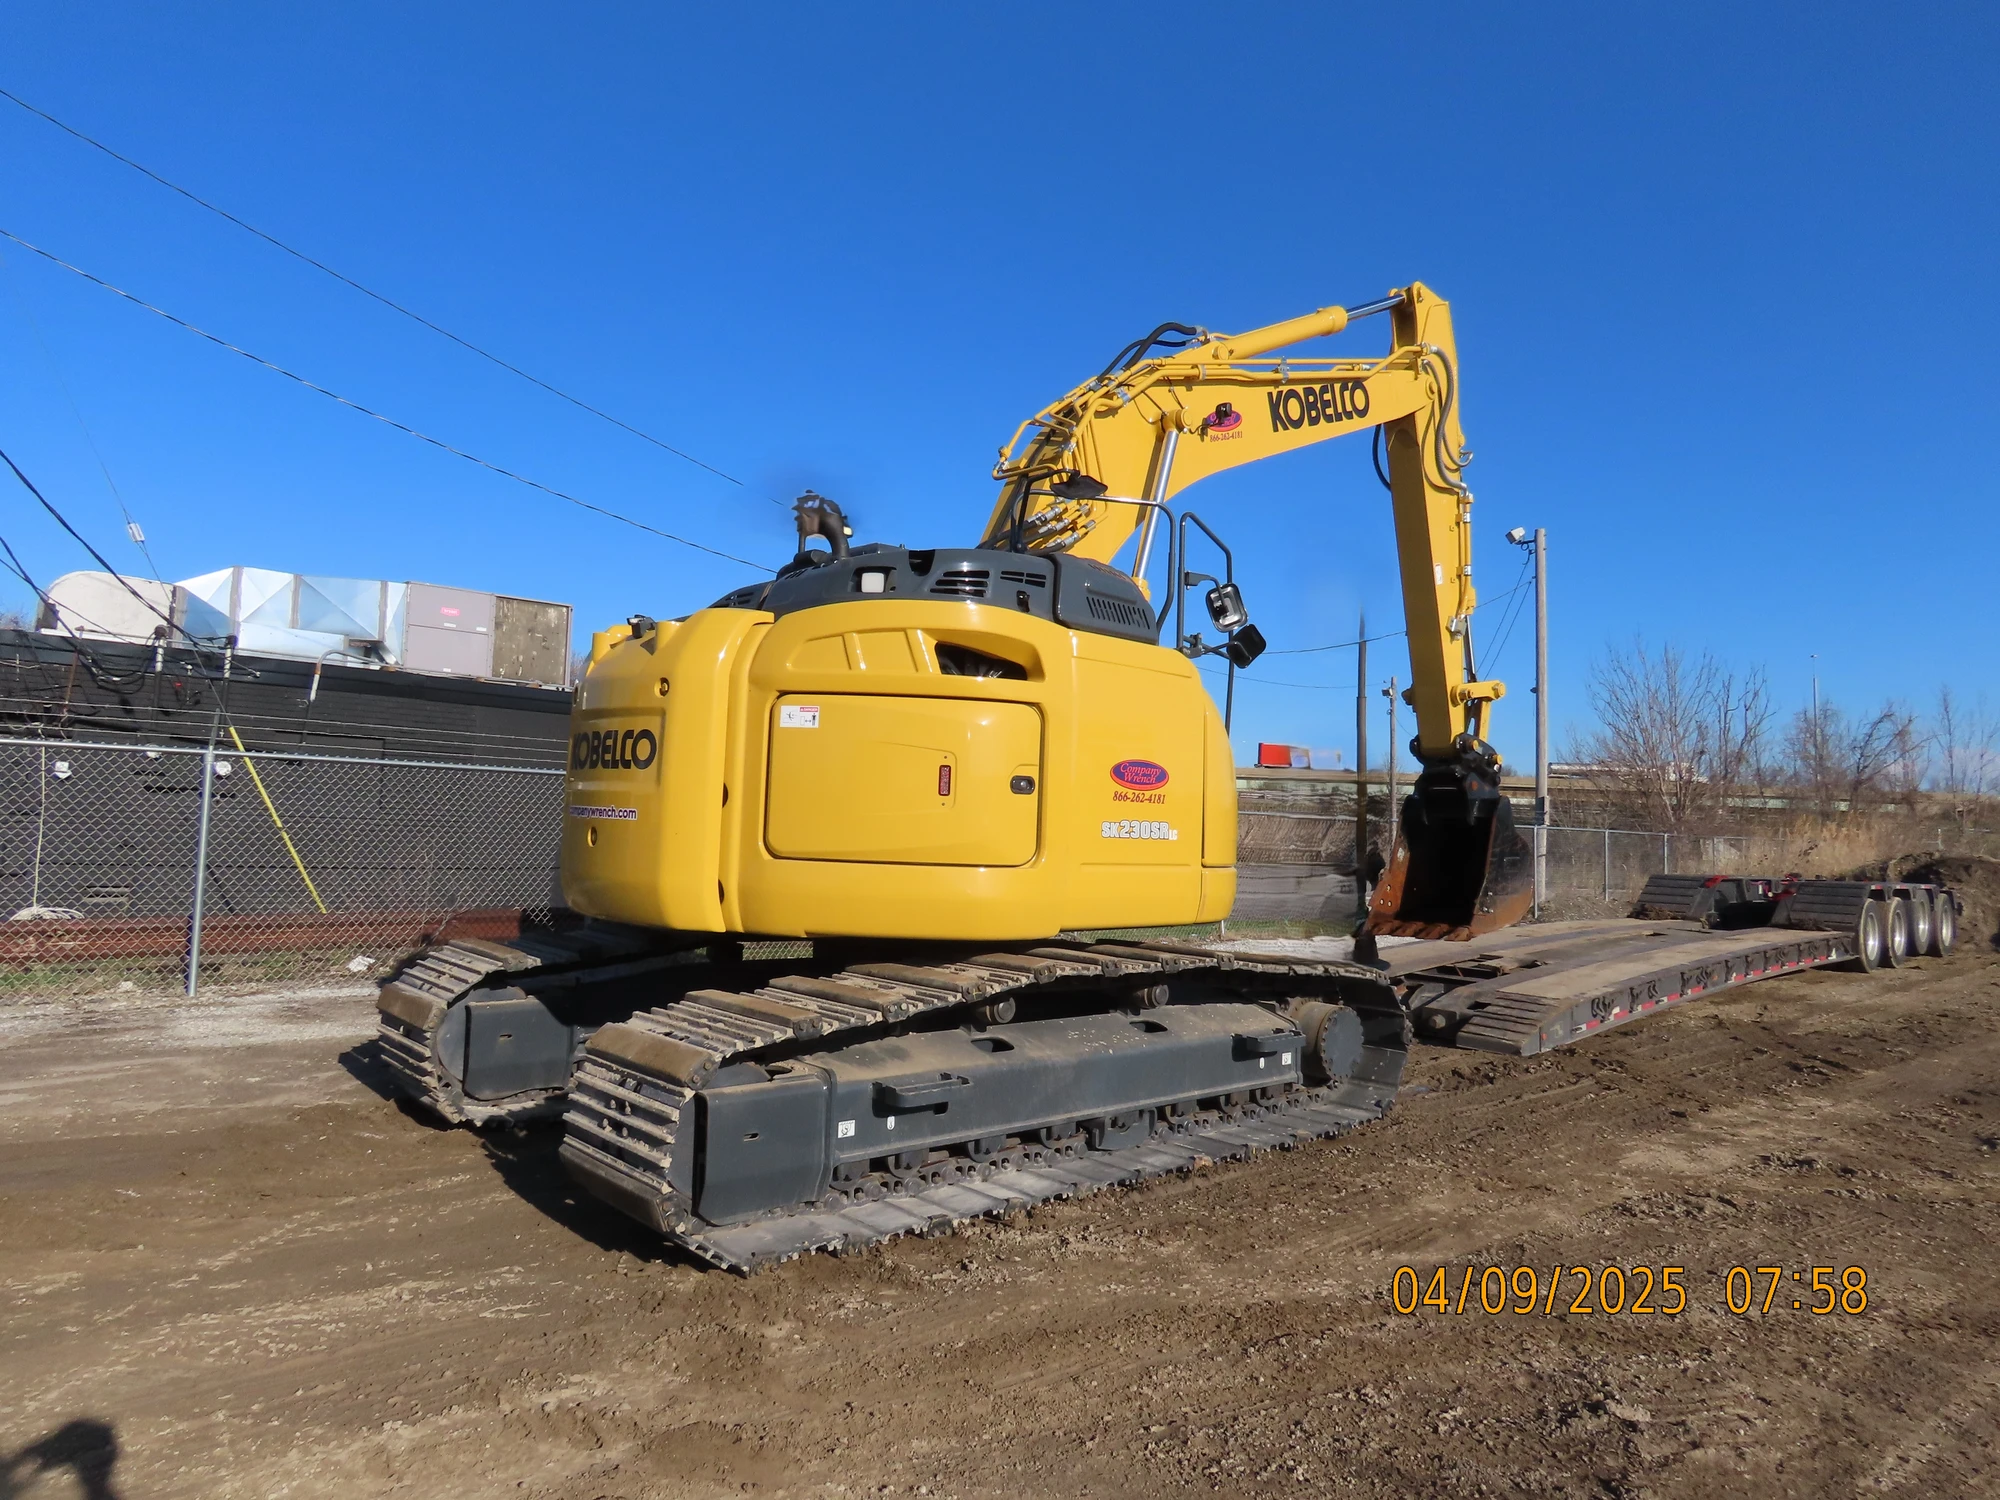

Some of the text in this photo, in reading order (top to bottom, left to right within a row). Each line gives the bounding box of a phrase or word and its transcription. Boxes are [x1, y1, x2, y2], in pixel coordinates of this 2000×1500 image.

[1267, 381, 1370, 432] KOBELCO
[572, 729, 657, 770] KOBELCO
[1120, 762, 1161, 776] Company
[1124, 773, 1157, 783] Wrench
[1113, 791, 1166, 804] 866-262-4181
